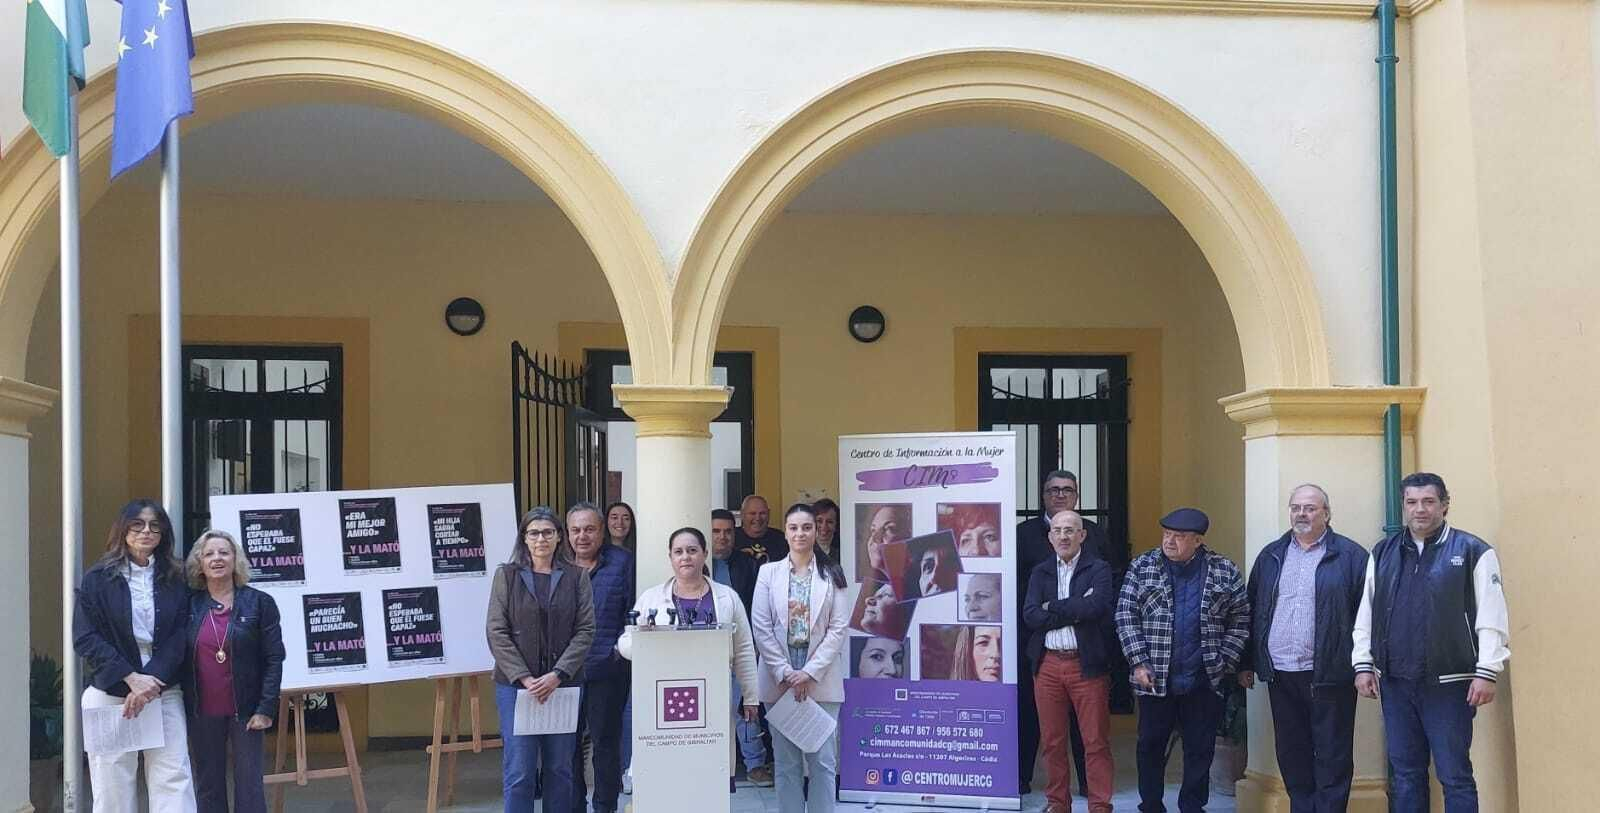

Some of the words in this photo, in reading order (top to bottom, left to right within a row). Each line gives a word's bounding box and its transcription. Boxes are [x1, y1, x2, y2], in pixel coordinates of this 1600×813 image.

[850, 448, 880, 458] Centro
[883, 448, 893, 458] de
[896, 448, 952, 458] Información
[964, 447, 973, 456] la
[976, 446, 1004, 458] Mujer
[904, 464, 948, 488] CIM
[346, 520, 357, 529] MI
[358, 519, 386, 528] MEJOR
[247, 530, 284, 538] ESPERABA
[273, 536, 295, 544] FUESE
[358, 544, 371, 554] LA
[372, 540, 400, 553] MATÓ
[446, 549, 458, 558] LA
[460, 545, 485, 557] MATÓ
[260, 556, 273, 567] LA
[276, 553, 304, 566] MATÓ
[389, 608, 423, 617] ESPERABA
[414, 614, 433, 622] FUESE
[322, 615, 342, 624] BUEN
[323, 641, 337, 651] LA
[338, 636, 365, 650] MATÓ
[402, 635, 414, 645] LA
[416, 630, 442, 644] MATÓ
[885, 725, 899, 734] 672
[901, 725, 914, 735] 467
[917, 726, 930, 735] 867
[937, 726, 951, 736] 956
[953, 727, 967, 737] 572
[969, 728, 983, 737] 680
